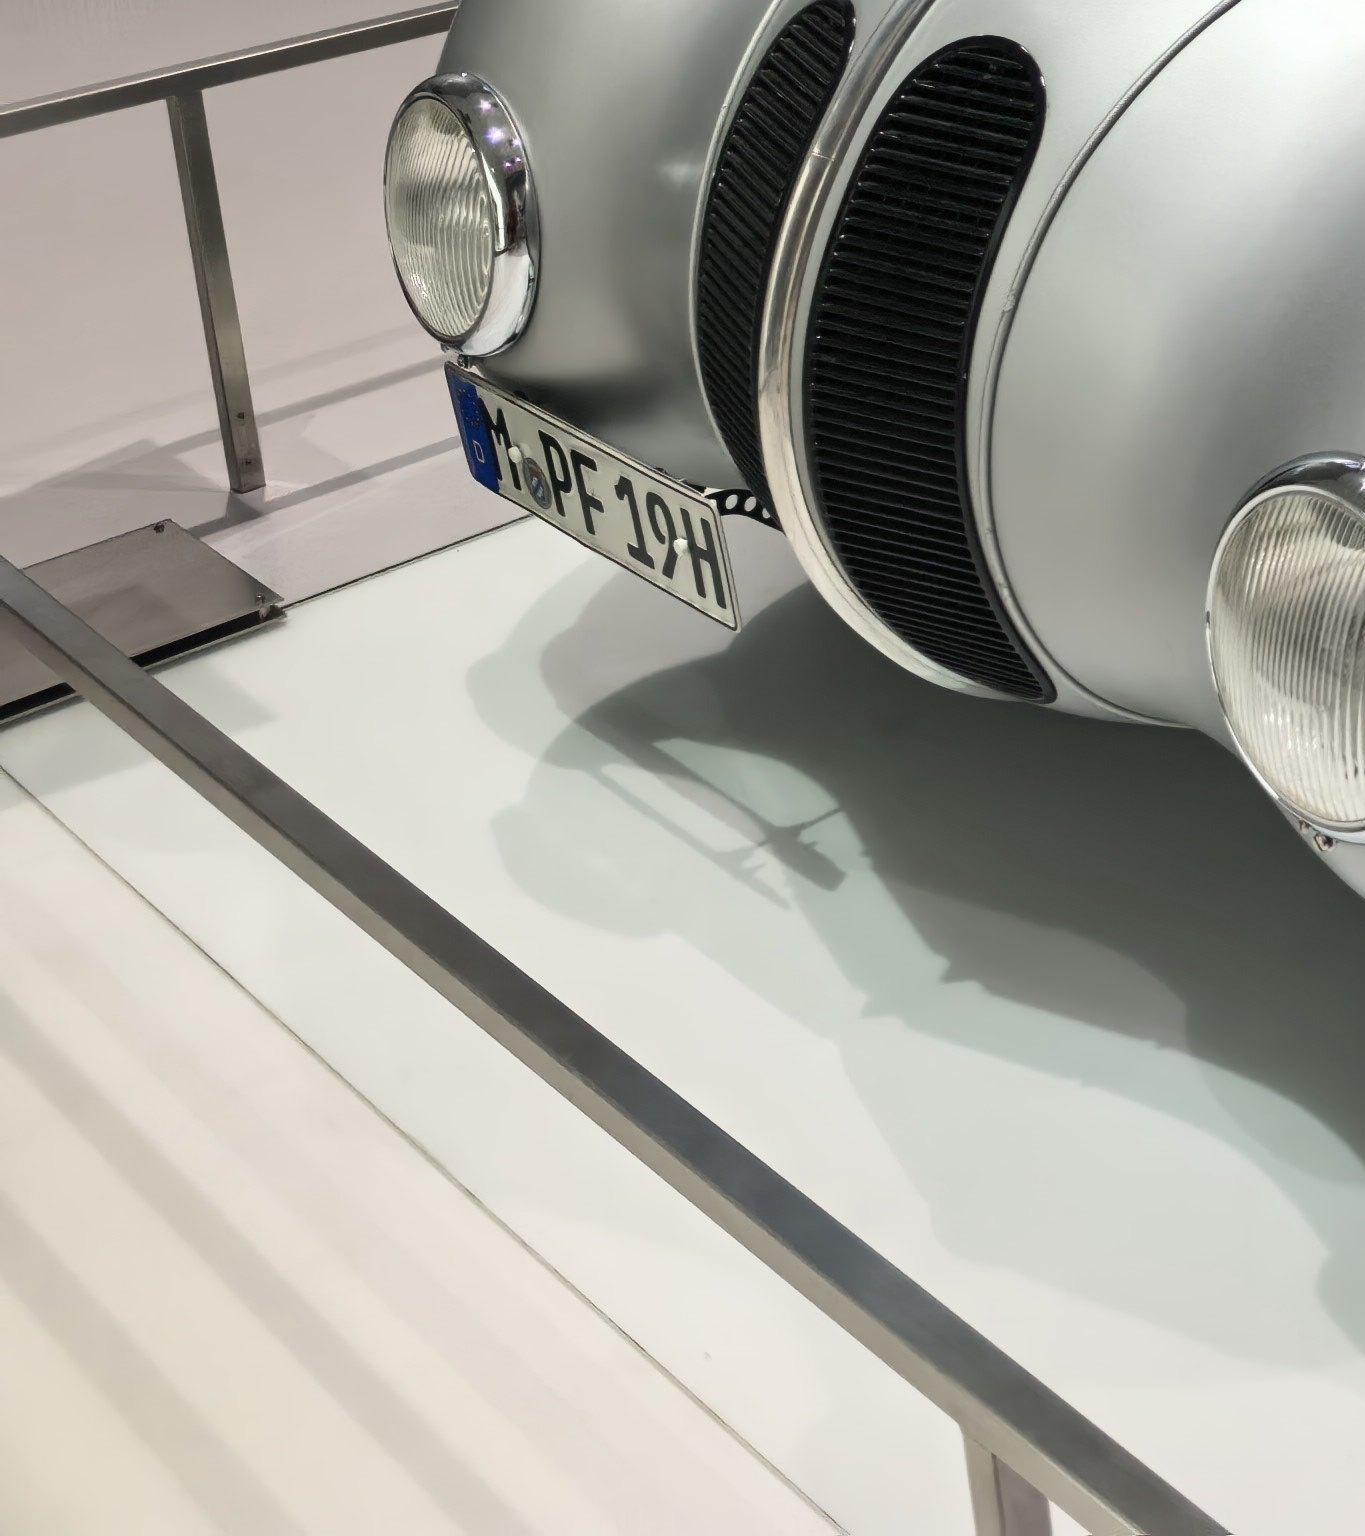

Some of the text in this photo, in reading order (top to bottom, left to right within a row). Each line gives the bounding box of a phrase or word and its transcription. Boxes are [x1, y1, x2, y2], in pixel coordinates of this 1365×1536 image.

[477, 396, 728, 610] M PF 19H
